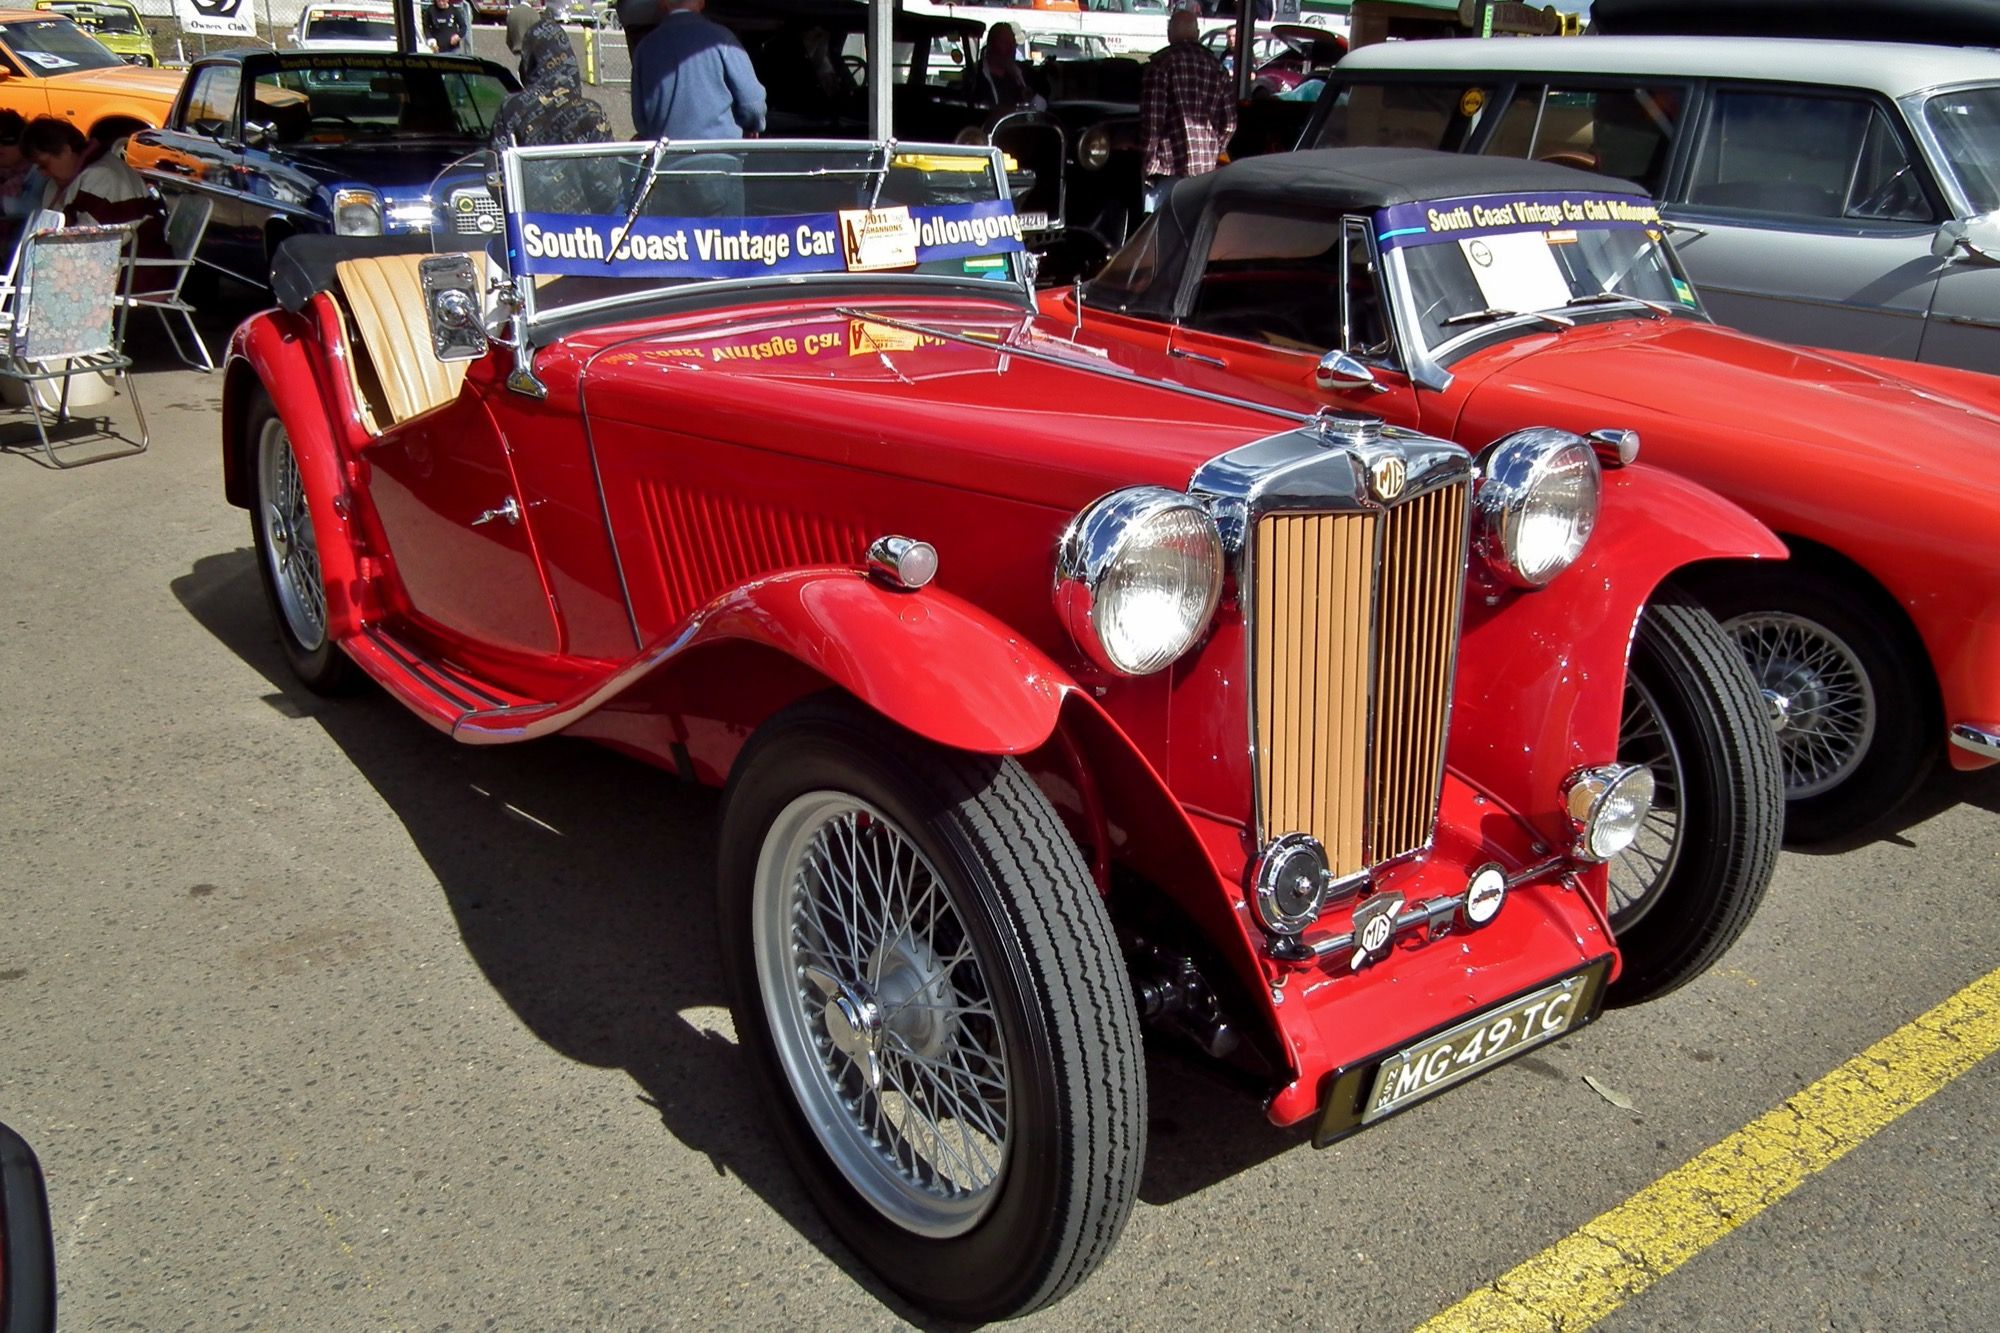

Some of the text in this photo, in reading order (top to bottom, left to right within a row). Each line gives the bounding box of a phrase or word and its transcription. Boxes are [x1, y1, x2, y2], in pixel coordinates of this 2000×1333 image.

[227, 22, 247, 31] Club
[866, 224, 903, 234] SHANNONS
[1427, 206, 1474, 232] South
[1472, 203, 1516, 227] Coast
[1512, 201, 1563, 226] Vintage
[1562, 199, 1585, 221] Car
[1583, 199, 1610, 221] Club
[523, 223, 604, 259] South
[610, 226, 689, 261] Coast
[693, 228, 790, 266] Vintage
[796, 225, 836, 257] Car
[1377, 458, 1404, 497] MG
[1364, 916, 1388, 950] MG
[1378, 1067, 1399, 1107] NSW
